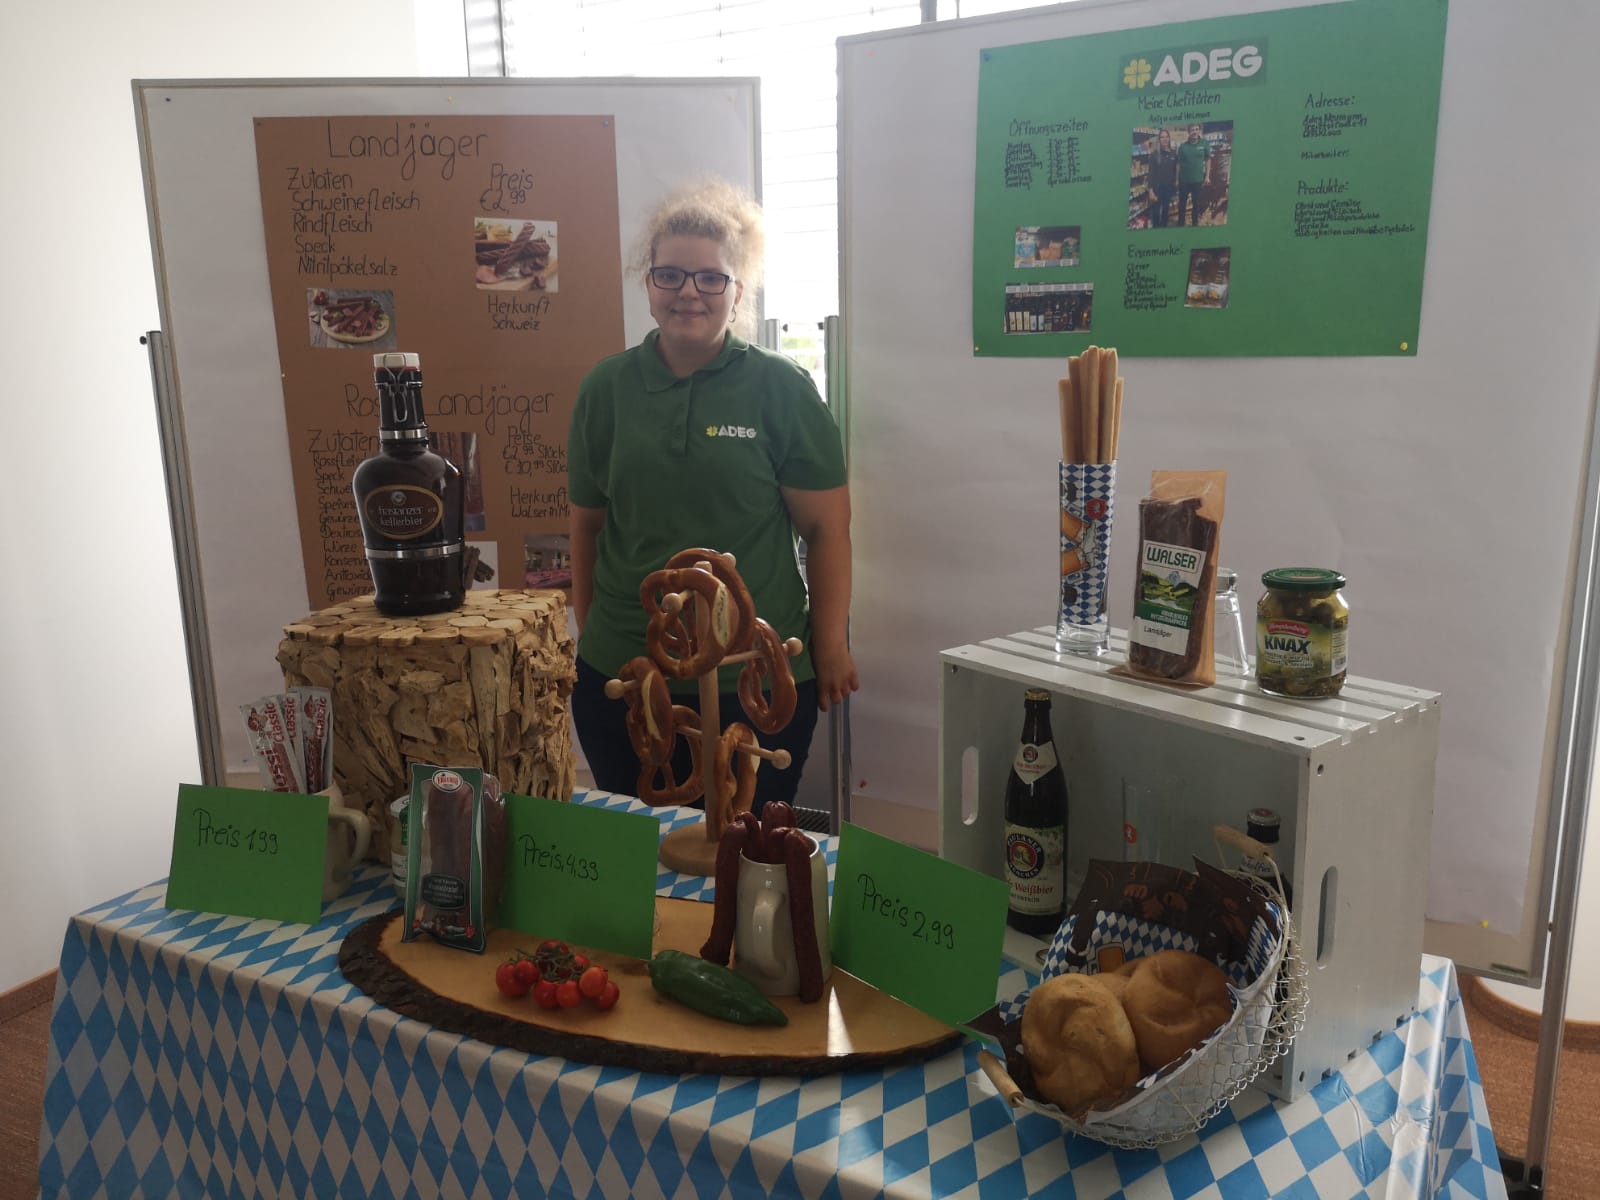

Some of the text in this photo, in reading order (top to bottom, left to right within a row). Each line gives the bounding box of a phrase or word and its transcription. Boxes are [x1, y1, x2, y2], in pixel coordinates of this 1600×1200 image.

[1153, 45, 1262, 86] ADEG
[1304, 91, 1355, 109] Adresse:
[327, 119, 488, 181] Landjäger
[286, 167, 353, 191] Zutaten
[491, 162, 535, 192] Preis
[1297, 177, 1350, 196] Produkte:
[291, 188, 420, 216] Schweinefleisch
[295, 235, 336, 259] Speck
[487, 295, 550, 317] Herkunft
[492, 314, 540, 332] Schweiz
[423, 384, 554, 436] andjäger
[718, 425, 756, 438] ADEG
[1146, 545, 1197, 569] WALSER
[1264, 635, 1311, 655] KNAX
[265, 702, 285, 744] Classic
[193, 807, 240, 848] Preis
[857, 873, 954, 950] Preis 2,99
